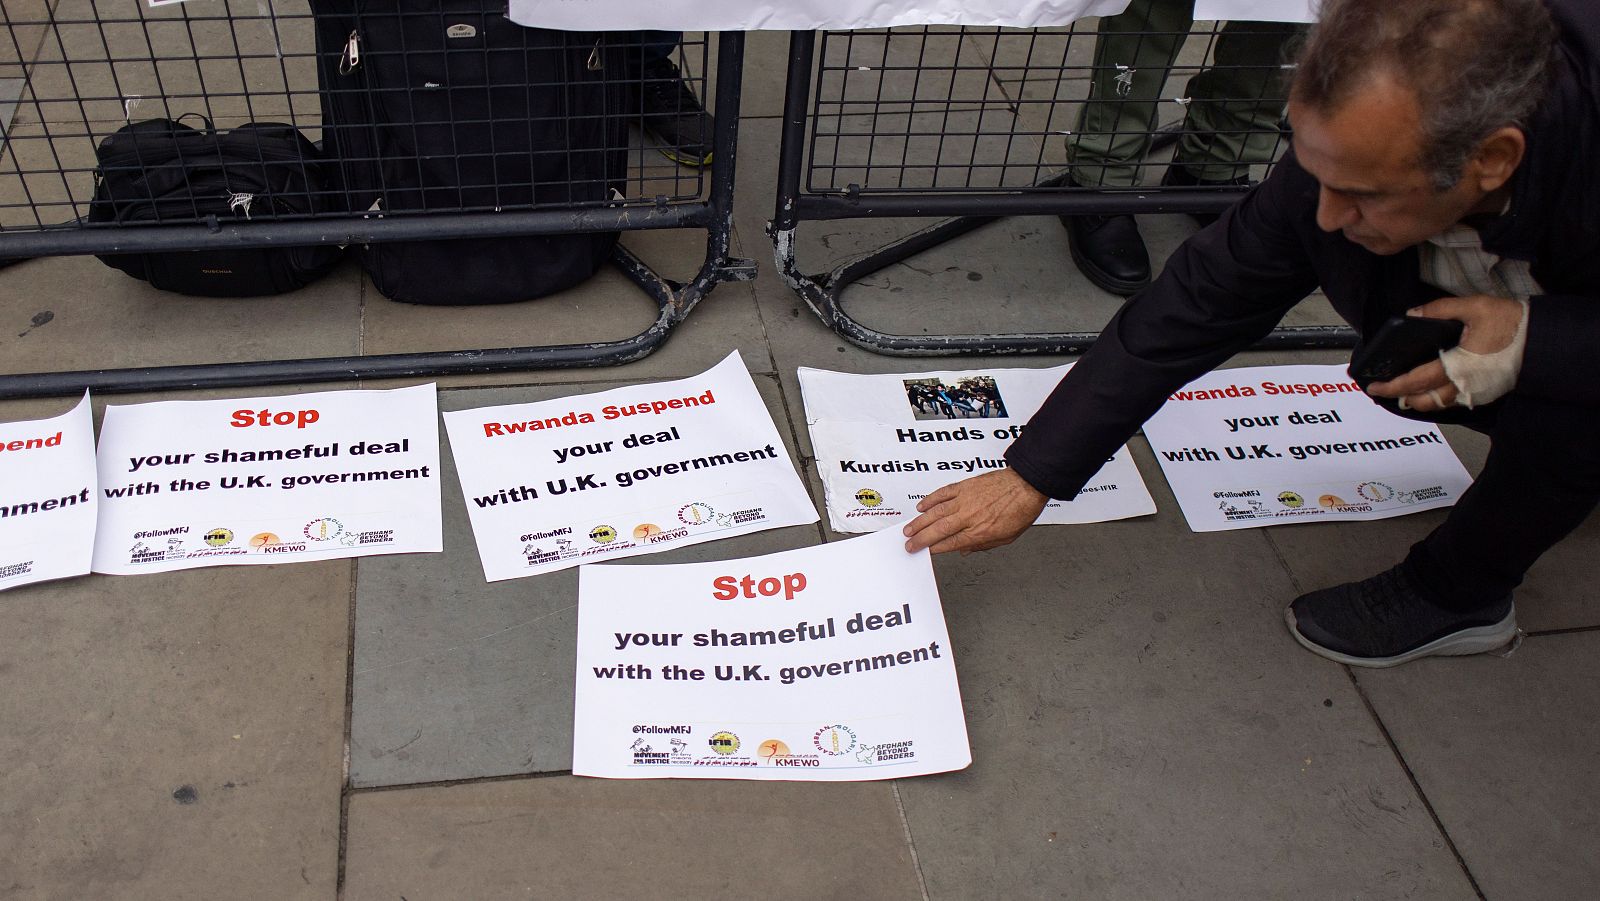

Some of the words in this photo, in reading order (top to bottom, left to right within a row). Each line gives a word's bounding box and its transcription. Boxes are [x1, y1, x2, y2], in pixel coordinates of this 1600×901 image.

[1168, 384, 1257, 401] wanda
[230, 408, 320, 429] Stop
[483, 411, 596, 438] Rwanda
[601, 389, 716, 420] Suspend
[1223, 415, 1280, 433] your
[1287, 409, 1343, 425] deal
[895, 426, 985, 443] Hands
[552, 440, 614, 464] your
[622, 426, 681, 449] deal
[1161, 447, 1221, 462] with
[1223, 444, 1283, 461] U.K.
[1288, 430, 1443, 461] government
[128, 453, 196, 473] your
[203, 442, 339, 464] shameful
[349, 438, 409, 456] deal
[839, 459, 930, 474] Kurdish
[103, 481, 160, 499] with
[169, 478, 211, 492] the
[219, 475, 272, 489] U.K.
[281, 465, 430, 490] government
[473, 485, 539, 508] with
[545, 473, 608, 496] U.K.
[615, 443, 778, 488] government
[1213, 490, 1260, 498] @FollowMFJ
[1336, 505, 1373, 513] KMEWO
[133, 526, 190, 540] @FollowMFJ
[360, 529, 394, 537] AFGHANS
[520, 527, 572, 542] @FollowMFJ
[650, 530, 688, 543] KMEWO
[131, 550, 166, 559] MOVEMENT
[264, 545, 306, 554] KMEWO
[527, 550, 559, 560] MOVEMENT
[141, 555, 165, 564] JUSTICE
[538, 555, 561, 563] JUSTICE
[712, 572, 807, 601] Stop
[614, 632, 684, 651] your
[692, 617, 836, 647] shameful
[846, 603, 912, 634] deal
[592, 663, 652, 680] with
[661, 664, 706, 681] the
[714, 664, 770, 681] U.K.
[779, 641, 941, 685] government
[632, 725, 691, 734] @FollowMFJ
[813, 726, 834, 756] CARIBBEAN
[835, 725, 857, 756] SOLIDARITY
[876, 741, 913, 750] AFGHANS
[876, 747, 909, 755] BEYOND
[877, 751, 915, 761] BORDERS
[775, 759, 820, 767] KMEWO
